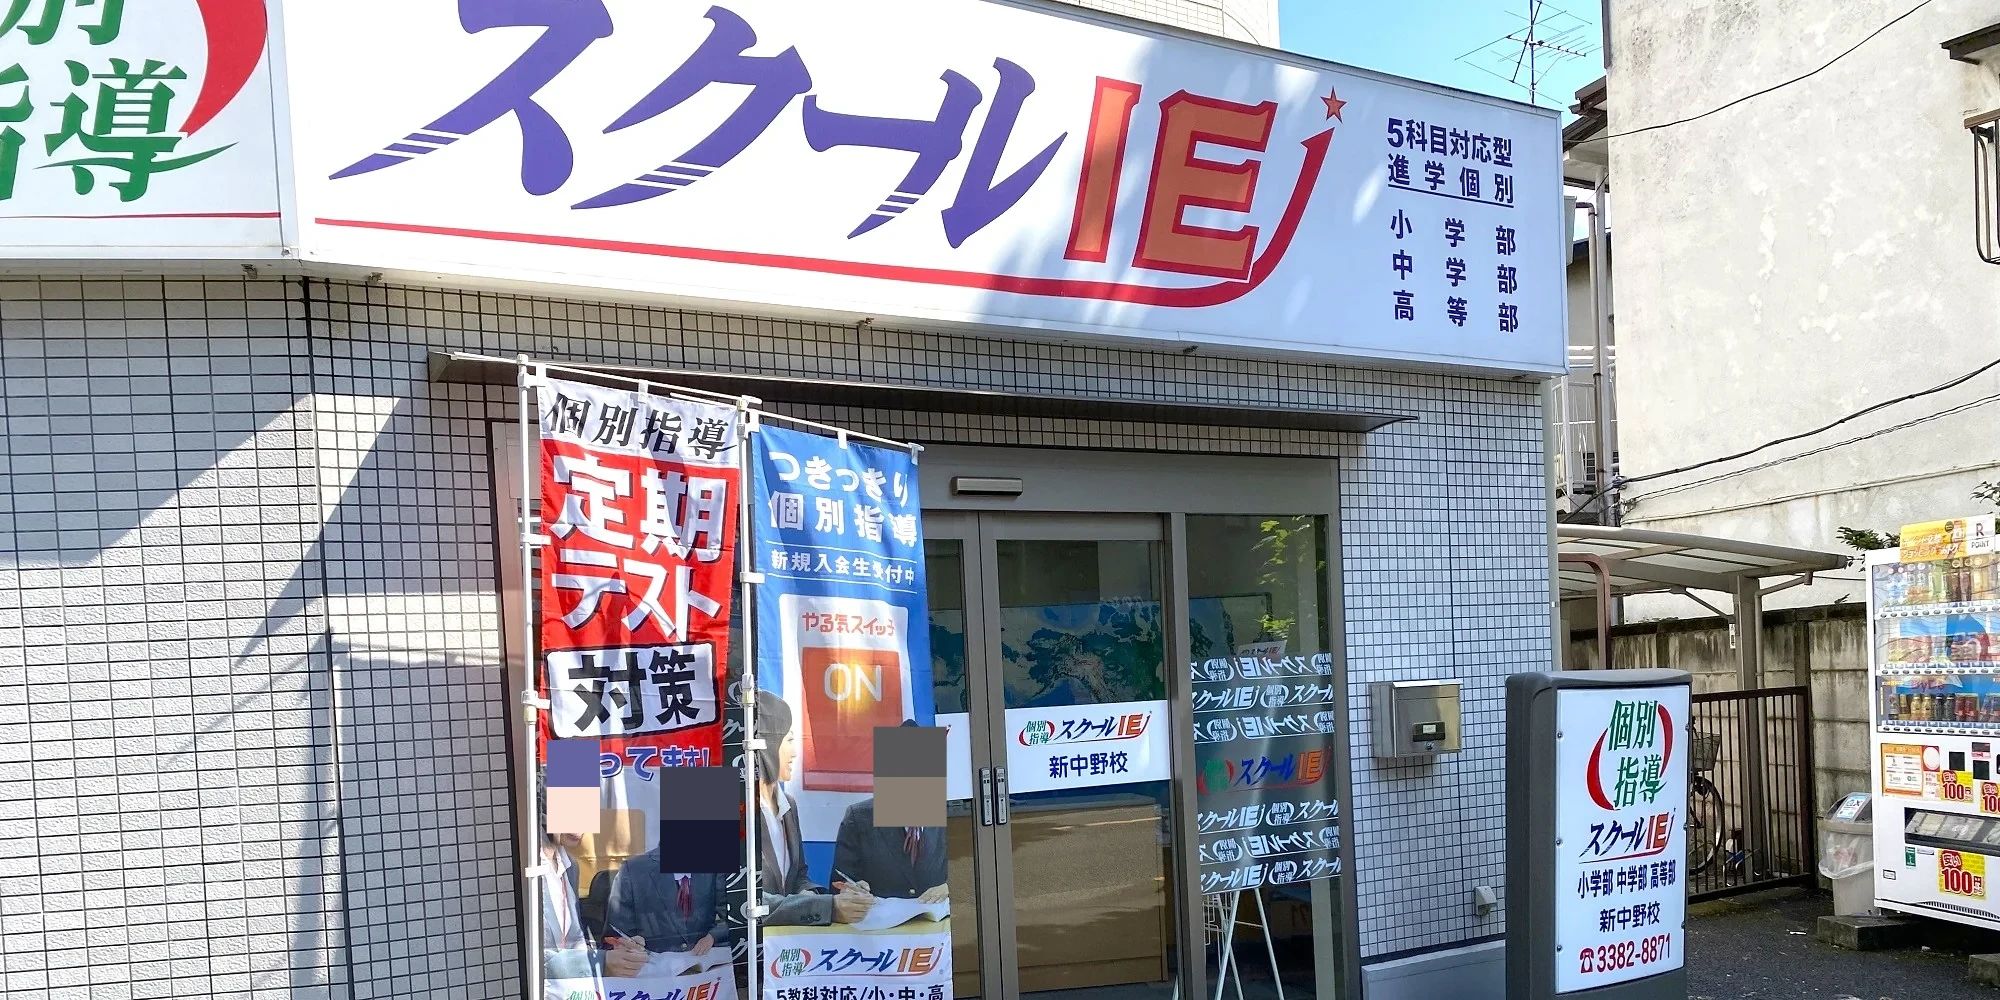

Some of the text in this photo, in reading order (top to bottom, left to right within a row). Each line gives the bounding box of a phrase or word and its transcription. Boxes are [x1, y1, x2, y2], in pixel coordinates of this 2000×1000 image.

[0, 58, 188, 203] 導
[1387, 117, 1514, 169] 5科目対応型
[1387, 153, 1515, 204] 進学個別
[1390, 208, 1517, 256] 小学部
[1392, 249, 1518, 294] 中学部
[1393, 289, 1519, 333] 高等部
[545, 392, 738, 460] 個別指導
[769, 451, 909, 508] つきっきり
[549, 453, 728, 564] 定期
[768, 490, 918, 548] 個別指導
[771, 549, 915, 586] 新規入会生受付中
[551, 549, 721, 643] テスト
[802, 611, 896, 637] やる気スイッチ
[567, 649, 698, 732] 対策
[823, 663, 882, 702] ON
[1026, 720, 1047, 733] 個別
[1028, 732, 1051, 745] 指導
[1053, 713, 1144, 741] スクールIE
[1608, 700, 1658, 751] 個別
[1049, 751, 1129, 778] 新中野校
[1233, 750, 1323, 787] スクールIE
[1612, 755, 1667, 808] 指導
[1579, 812, 1671, 859] スクールIE
[1578, 859, 1677, 900] 小学部 中学部 高等部
[1599, 901, 1661, 932] 新中野校
[779, 948, 801, 963] 個別
[782, 962, 805, 976] 指導
[808, 947, 935, 974] スクールIE
[1597, 933, 1671, 974] 3382-8871
